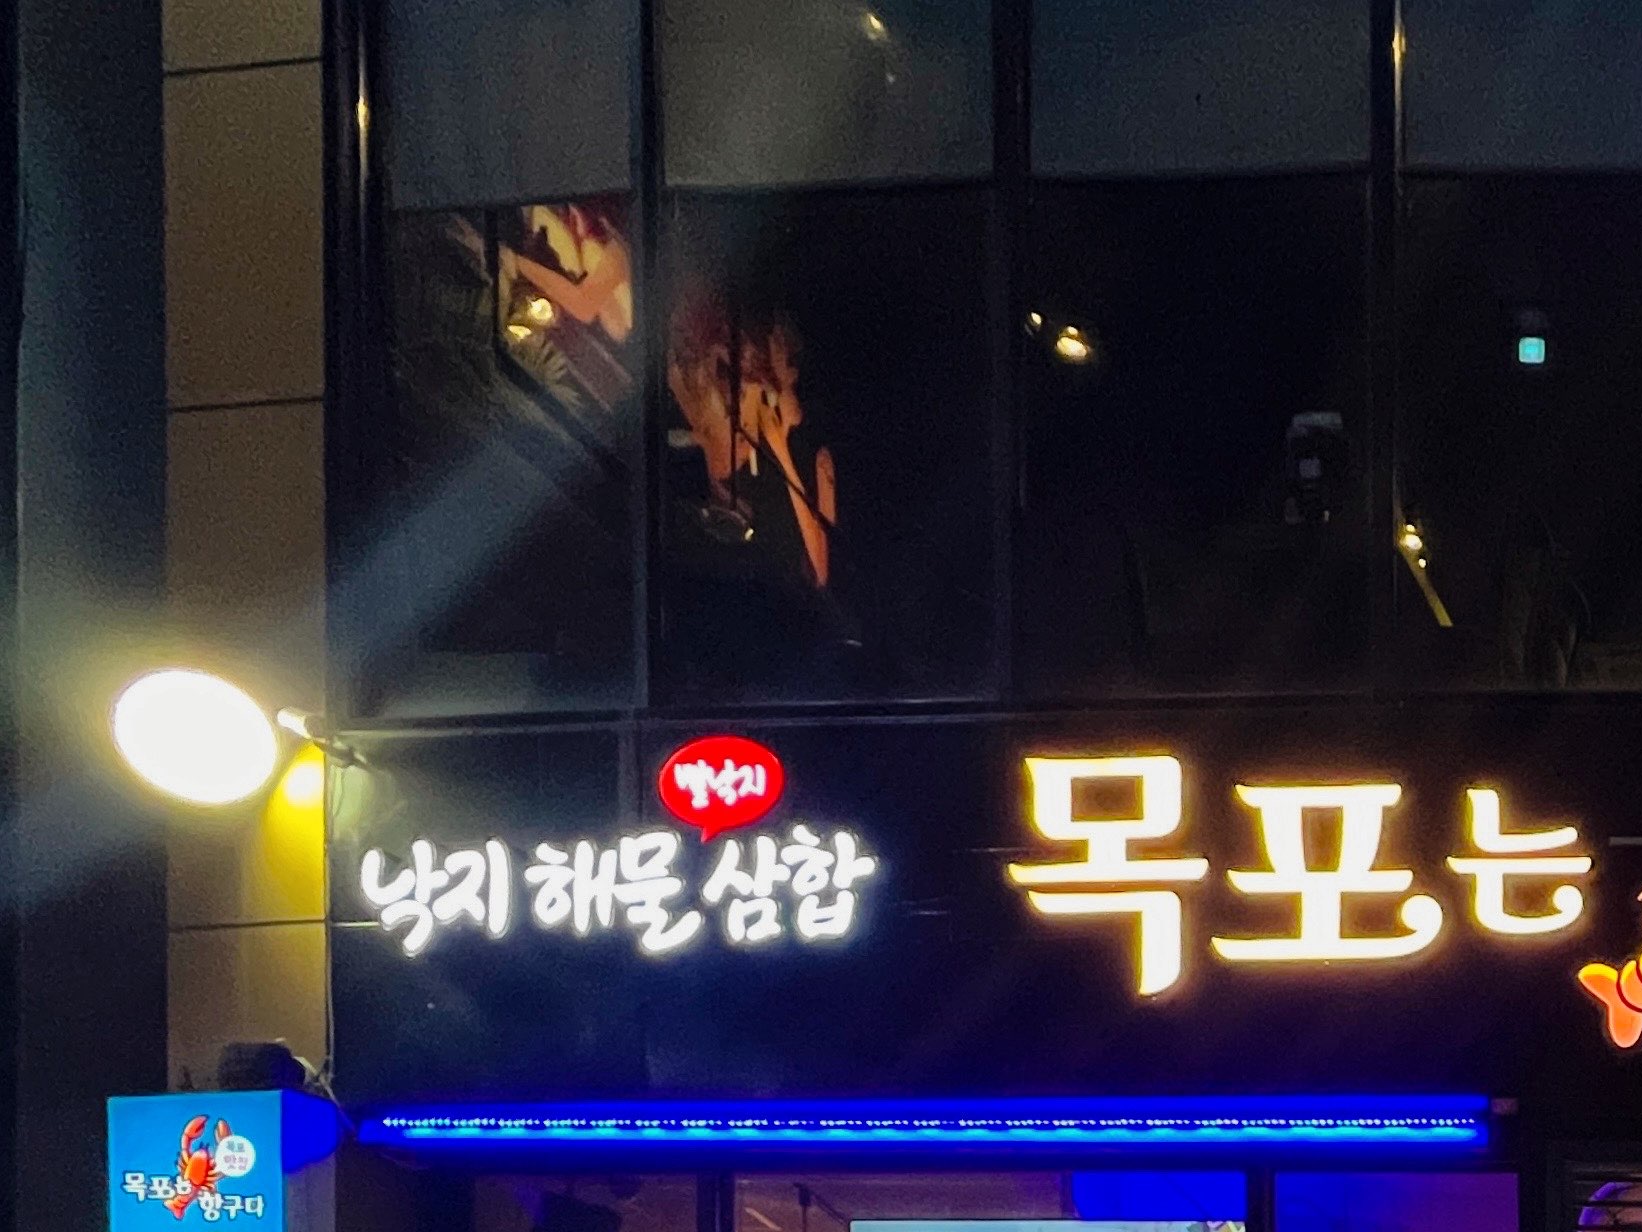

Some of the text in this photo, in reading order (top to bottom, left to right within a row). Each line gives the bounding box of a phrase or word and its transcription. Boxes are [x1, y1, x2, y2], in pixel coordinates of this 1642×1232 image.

[360, 838, 510, 957] 낙지
[1008, 755, 1592, 996] 목포는
[197, 1190, 265, 1222] 항구다
